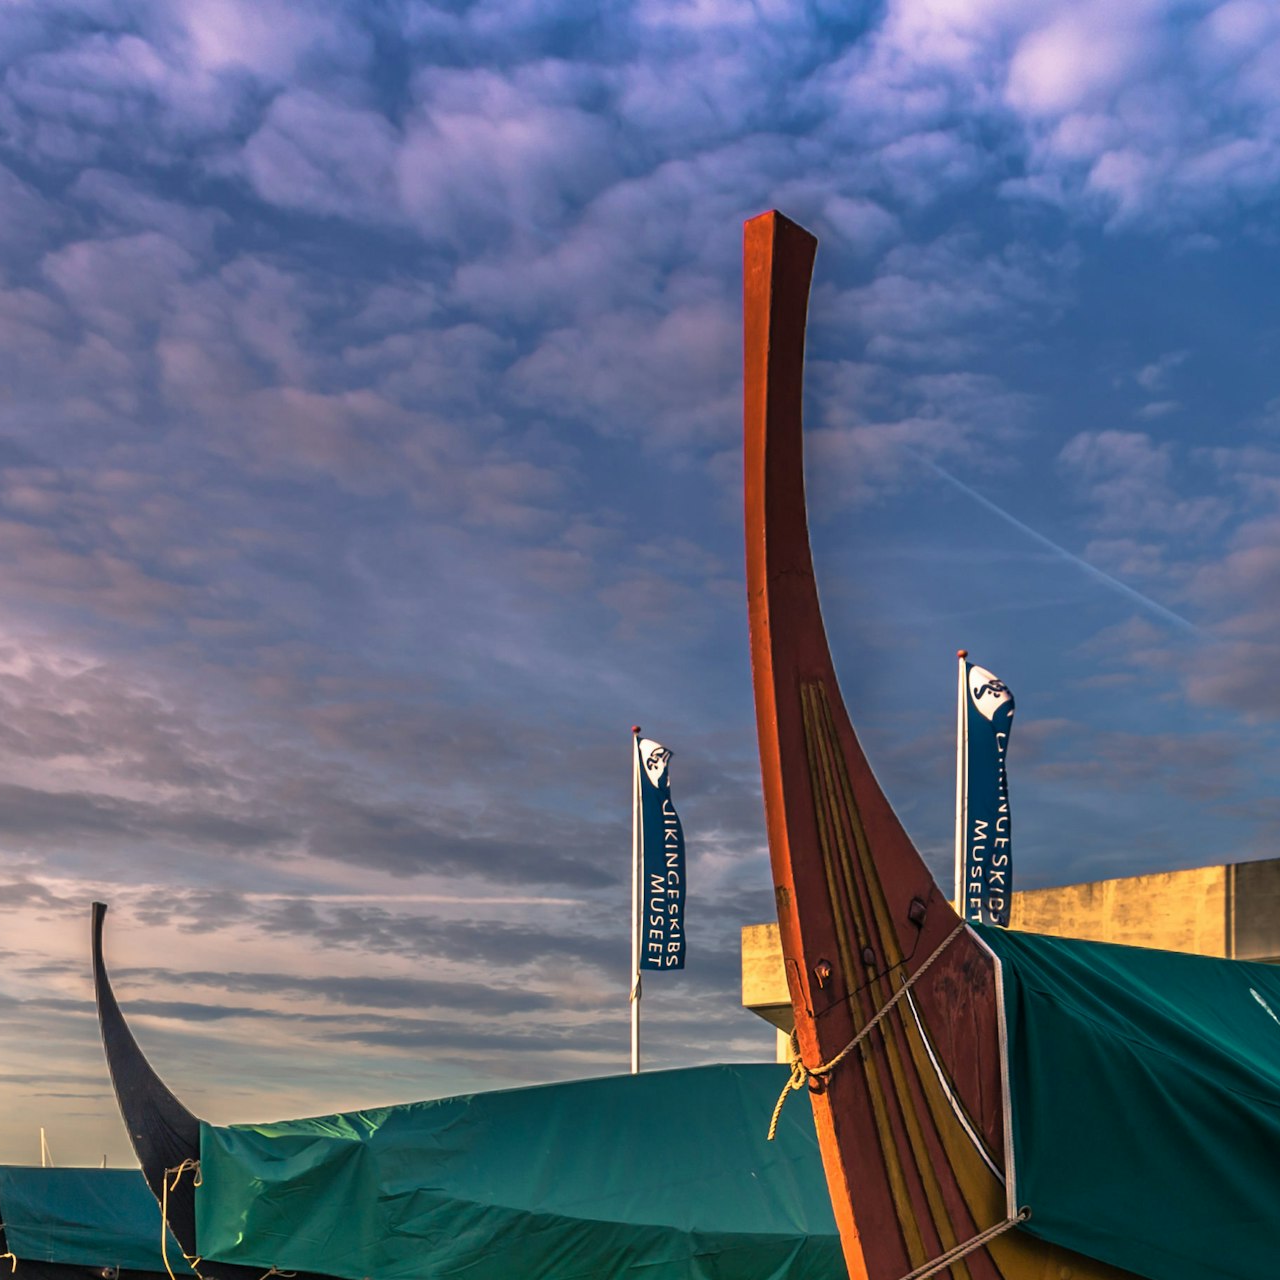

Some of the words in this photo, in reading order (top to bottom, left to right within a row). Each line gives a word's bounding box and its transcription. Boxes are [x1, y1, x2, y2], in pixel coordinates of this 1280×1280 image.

[968, 819, 988, 923] MUSEET
[988, 731, 1009, 923] NGESKIBS
[648, 874, 665, 967] MUSEET
